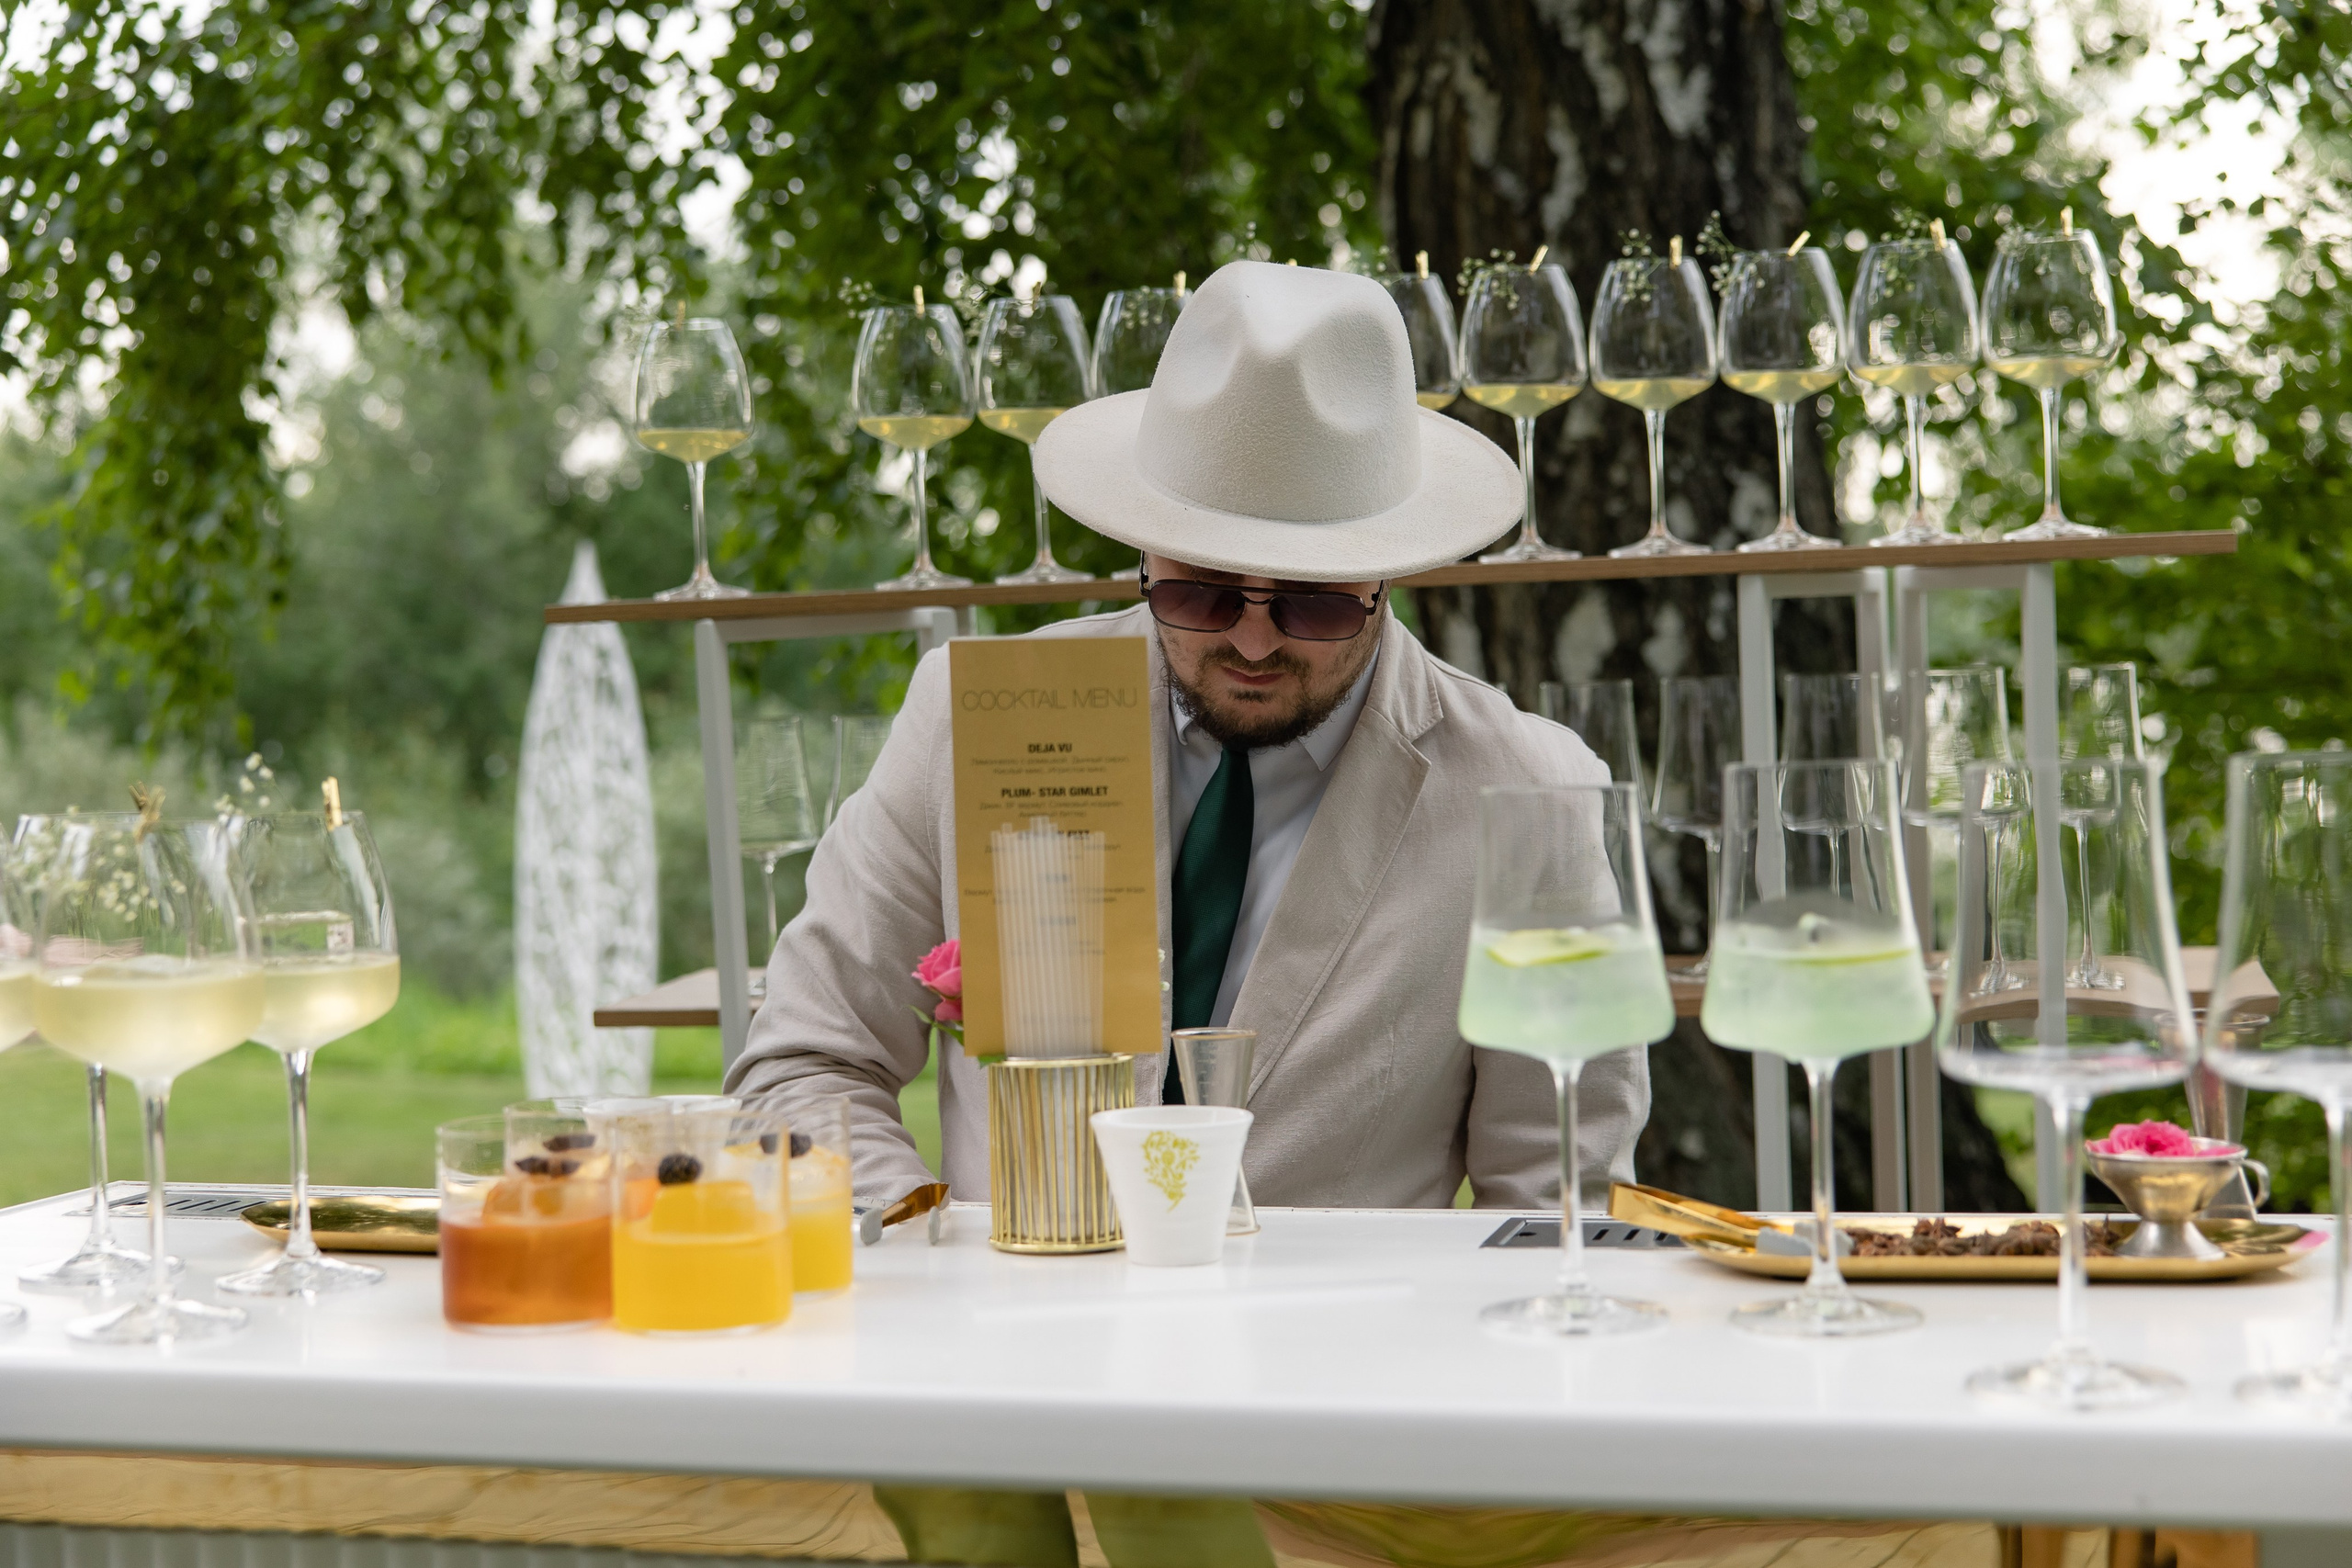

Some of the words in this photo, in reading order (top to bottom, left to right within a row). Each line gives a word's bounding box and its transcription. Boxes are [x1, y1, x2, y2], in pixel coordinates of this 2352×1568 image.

[963, 689, 1066, 712] COCKTAIL
[1072, 687, 1137, 709] MENU
[1028, 743, 1056, 753] DEJA
[1057, 743, 1072, 753] VU
[1001, 787, 1036, 798] PLUM-
[1038, 786, 1066, 797] STAR
[1069, 786, 1108, 797] GIMLET
